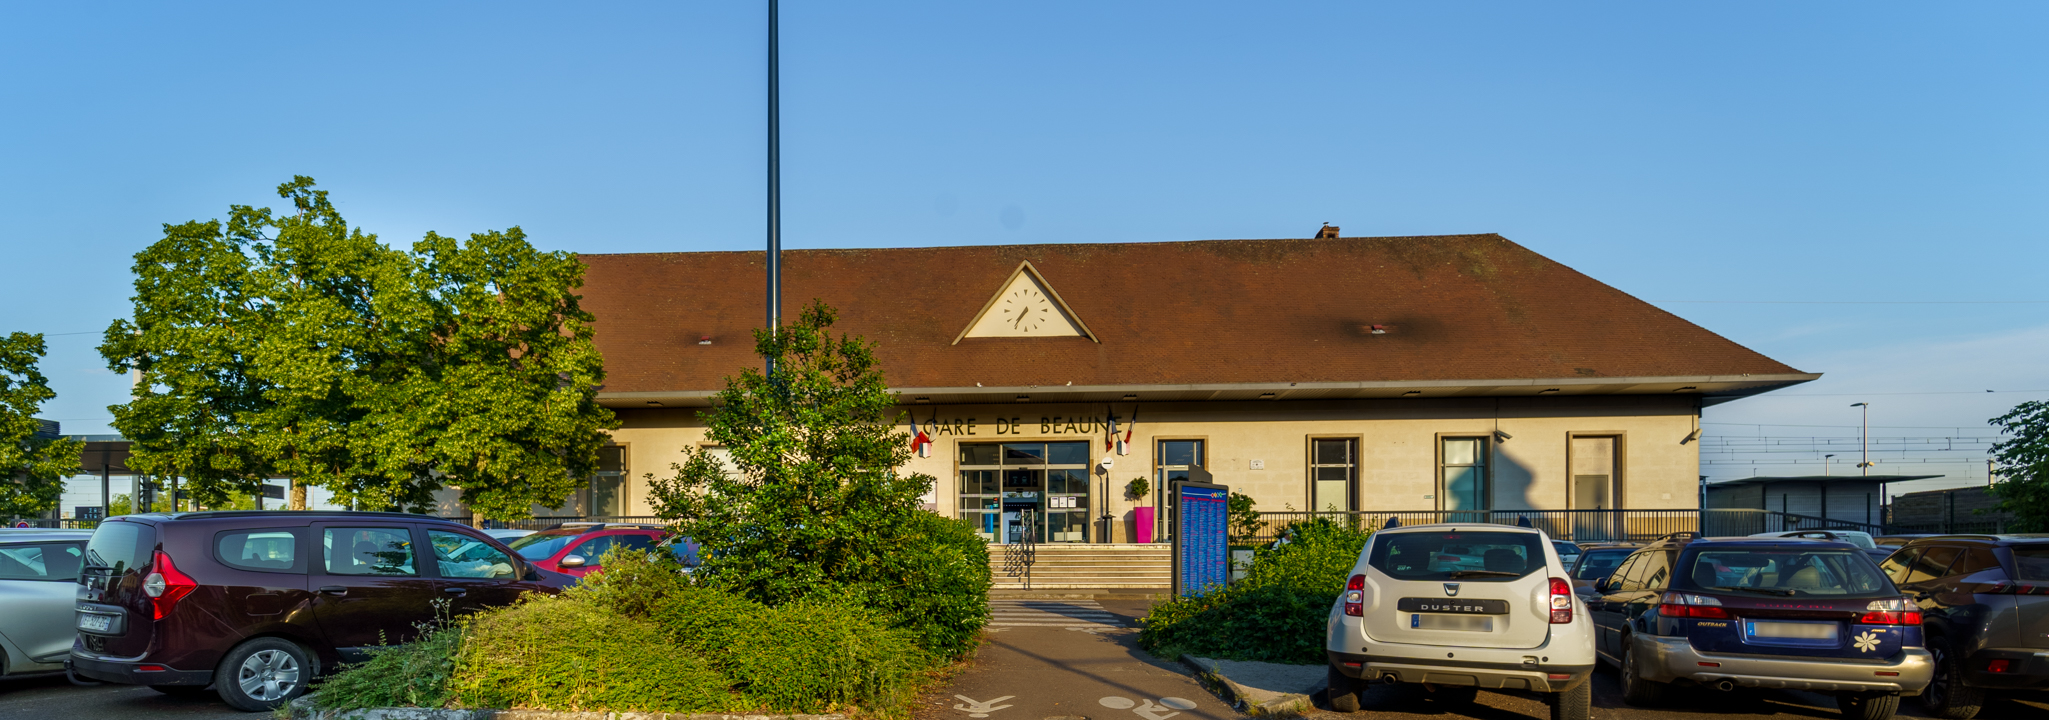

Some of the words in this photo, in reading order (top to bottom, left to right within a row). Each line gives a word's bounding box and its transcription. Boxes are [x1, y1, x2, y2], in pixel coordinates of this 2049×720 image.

[923, 417, 976, 436] GARE
[996, 417, 1020, 435] DE
[1040, 416, 1123, 435] BEAUNE
[1421, 604, 1484, 612] DUSTER
